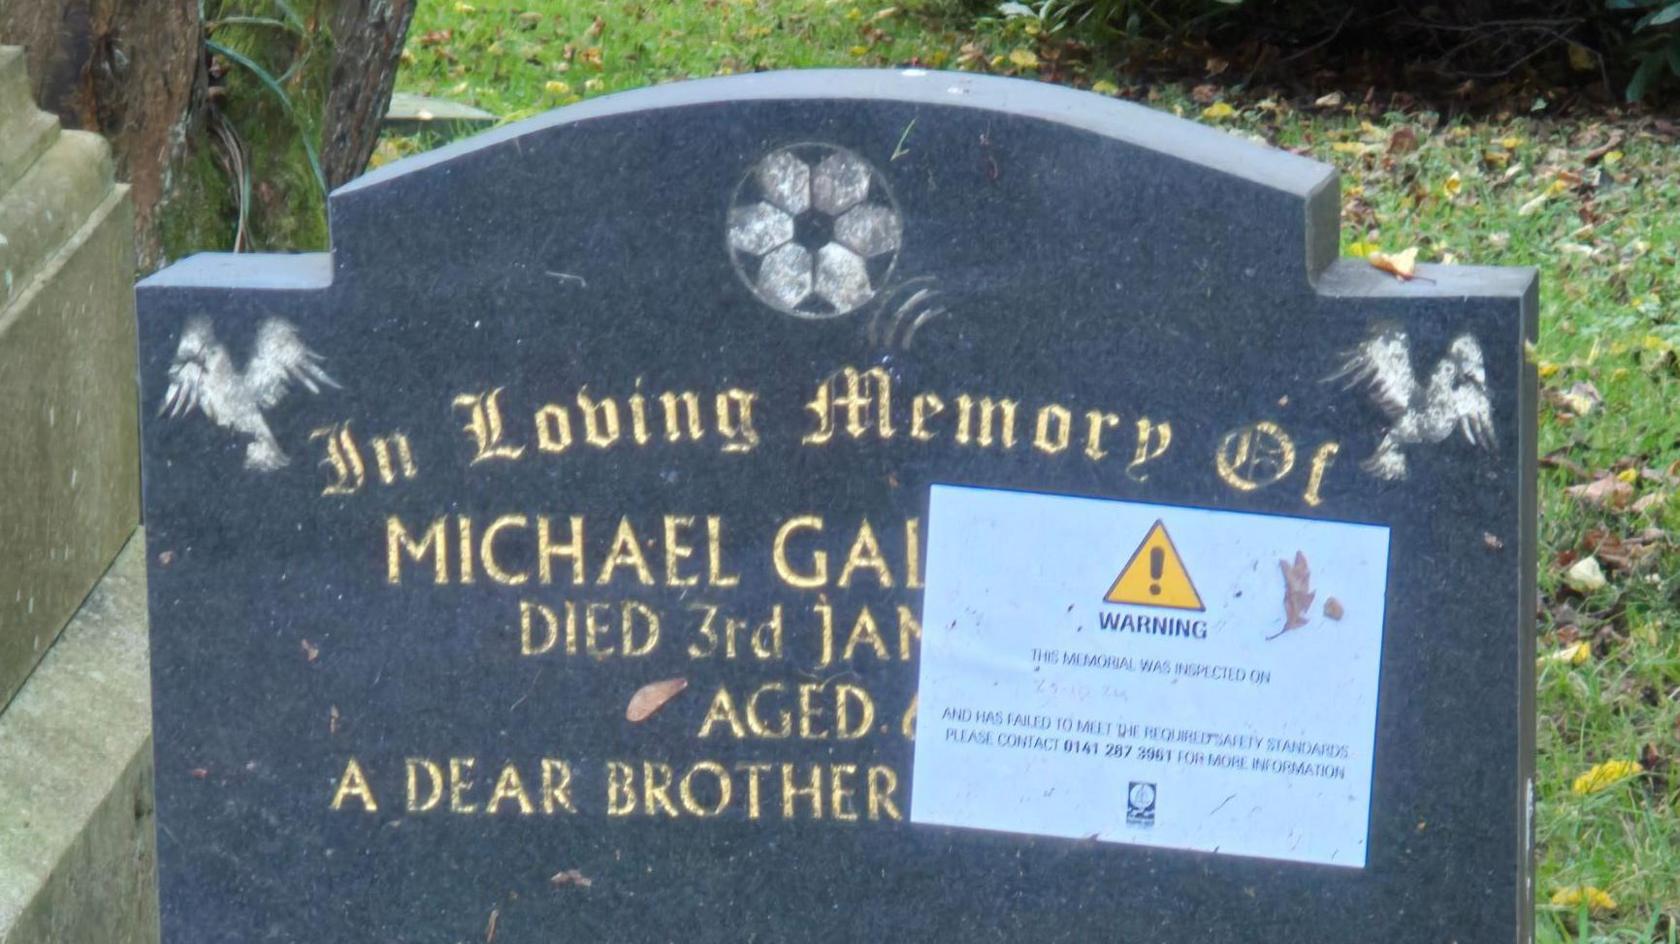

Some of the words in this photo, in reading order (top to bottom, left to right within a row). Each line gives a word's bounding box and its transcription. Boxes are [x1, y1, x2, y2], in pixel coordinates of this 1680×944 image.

[309, 421, 418, 497] In
[452, 378, 760, 467] Loving
[802, 366, 1173, 482] Memory
[1215, 420, 1340, 507] Of
[385, 514, 740, 588] MICHAEL
[772, 516, 925, 590] GAL
[519, 600, 661, 657] DIED
[687, 603, 783, 659] 3rd
[813, 594, 920, 668] JAN
[1099, 611, 1207, 637] WARNING
[1031, 648, 1060, 665] THIS
[1062, 650, 1136, 672] MEMORIAL
[1139, 658, 1172, 675] WAS
[1174, 662, 1247, 683] INSPECTED
[1249, 669, 1272, 686] ON
[697, 682, 876, 740] AGED
[941, 706, 972, 722] AND
[975, 710, 1004, 725] HAS
[1007, 712, 1052, 730] FAILED
[1056, 716, 1073, 732] TO
[1076, 719, 1112, 735] MEET
[1117, 722, 1140, 738] THE
[1144, 725, 1213, 746] REQUIRED
[1213, 733, 1264, 752] SAFETY
[1267, 737, 1350, 760] STANDARDS
[945, 727, 995, 746] PLEASE
[997, 731, 1059, 752] CONTACT
[1063, 738, 1100, 756] 0141
[1105, 743, 1133, 759] 287
[1137, 746, 1174, 763] 3961
[1177, 750, 1206, 767] FOR
[1208, 753, 1248, 771] MORE
[1252, 757, 1346, 781] INFORMATION
[330, 757, 378, 812] A
[405, 757, 577, 816] DEAR
[607, 759, 902, 822] BROTHER
